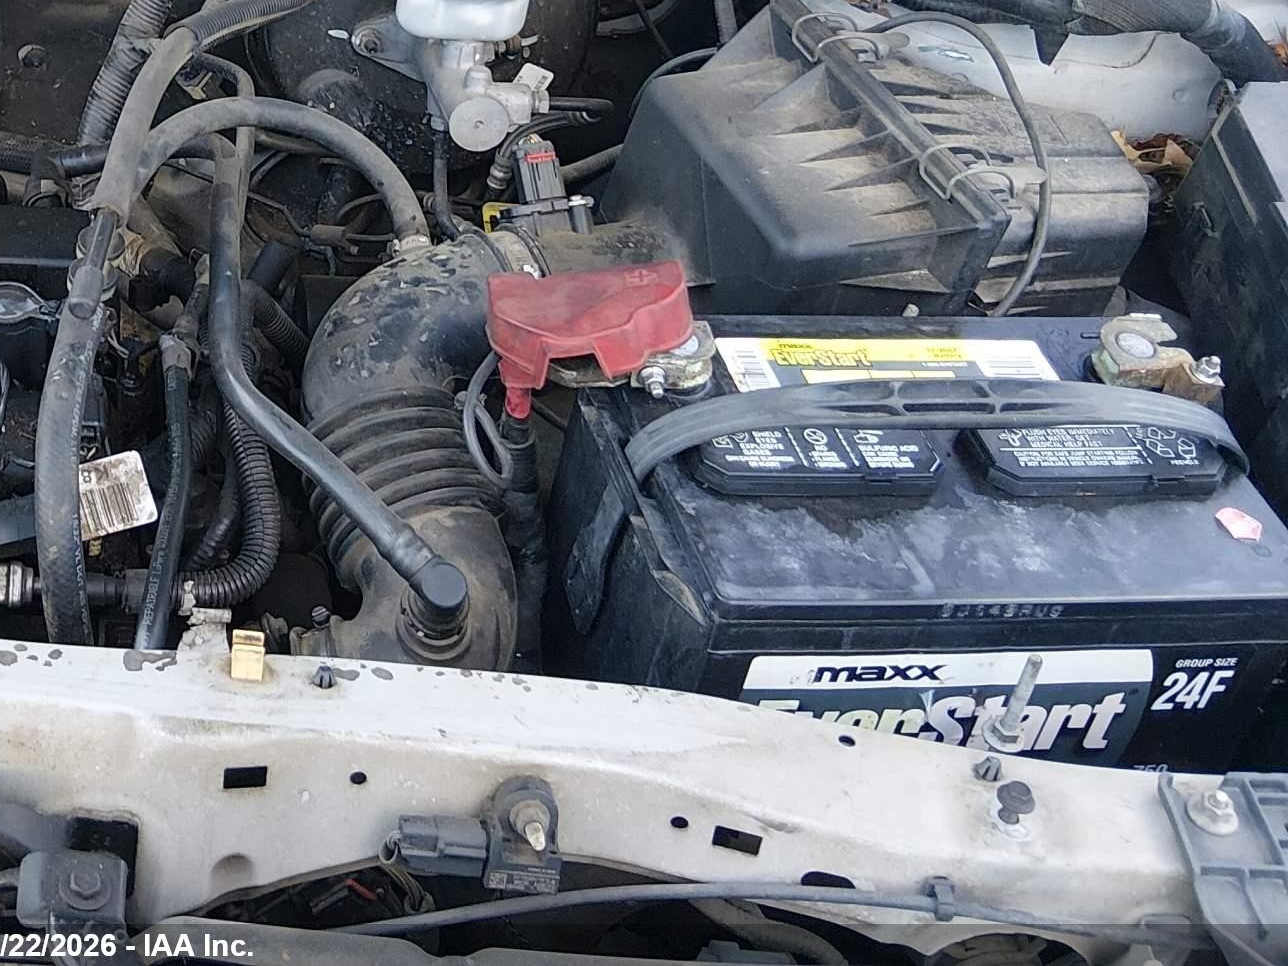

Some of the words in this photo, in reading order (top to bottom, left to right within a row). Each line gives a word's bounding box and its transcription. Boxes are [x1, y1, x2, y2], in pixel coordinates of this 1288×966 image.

[771, 349, 873, 367] EverStart
[1175, 658, 1213, 668] GROUP
[1213, 657, 1238, 667] SIZE
[811, 664, 947, 683] maxx
[1150, 670, 1235, 710] 24F
